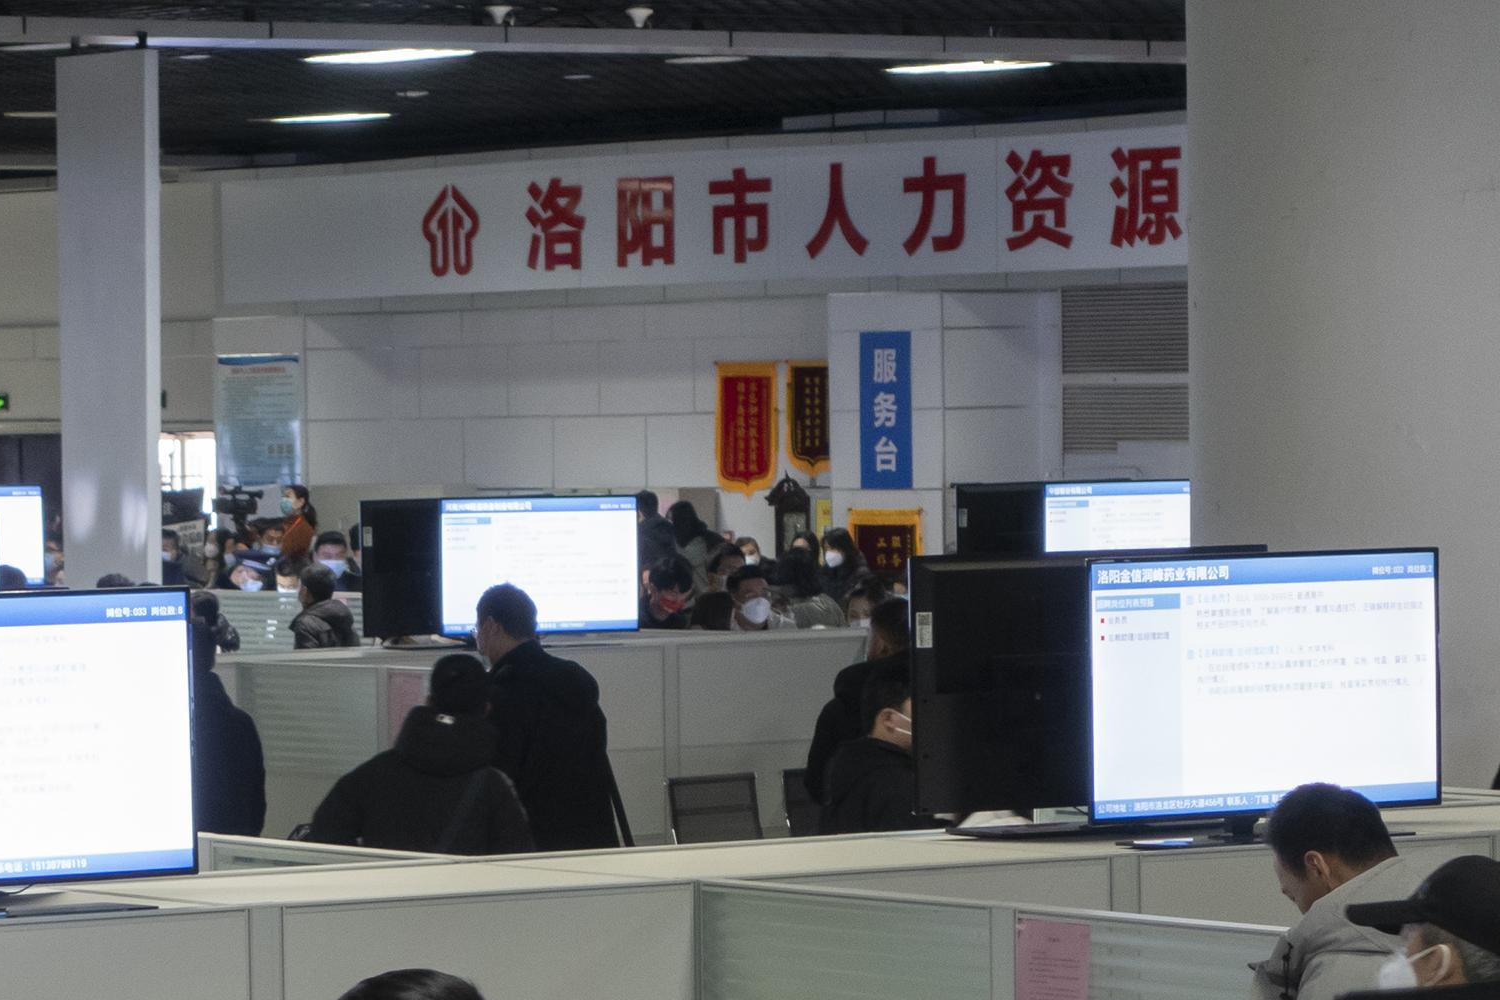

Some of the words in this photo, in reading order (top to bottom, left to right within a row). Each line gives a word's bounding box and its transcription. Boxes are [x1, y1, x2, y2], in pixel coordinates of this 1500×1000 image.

[525, 146, 1183, 271] 洛阳市人力资源
[874, 348, 897, 472] 服务台
